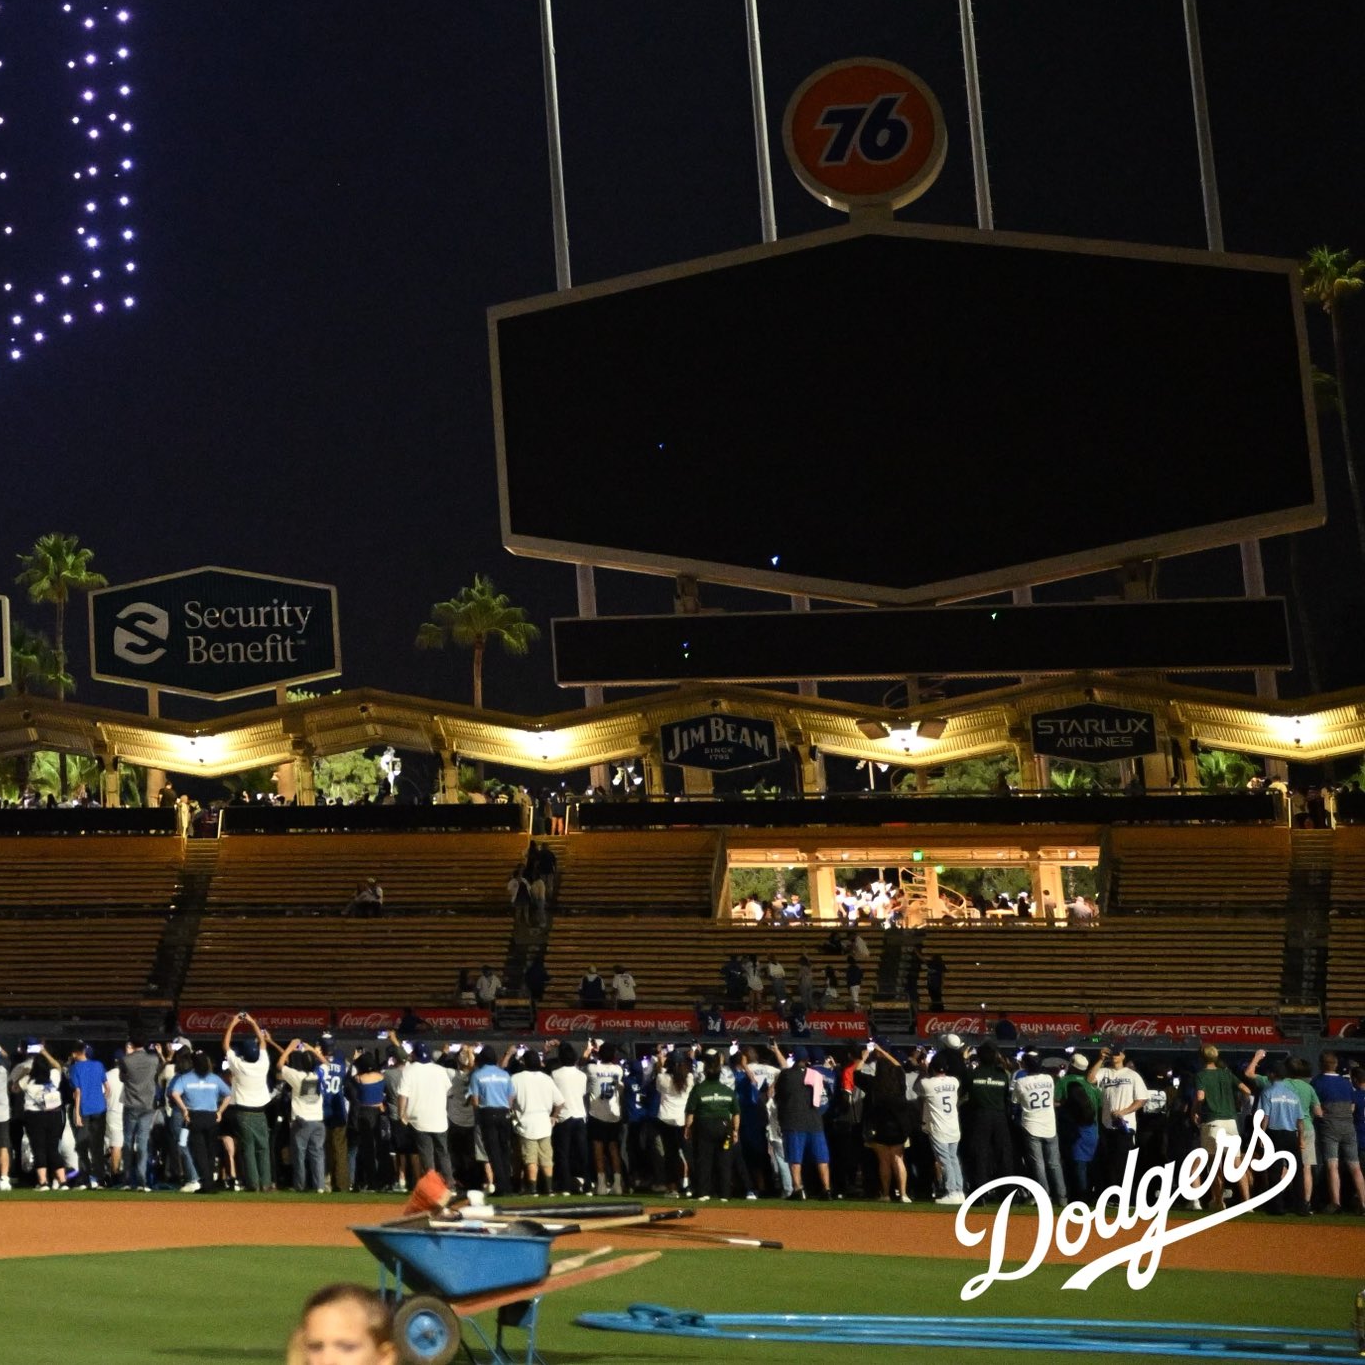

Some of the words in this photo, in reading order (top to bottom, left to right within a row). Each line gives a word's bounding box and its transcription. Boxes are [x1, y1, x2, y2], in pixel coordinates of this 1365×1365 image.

[814, 92, 913, 168] 76
[185, 597, 313, 634] Security
[187, 634, 297, 665] Benefit
[1036, 719, 1149, 735] STARLUX
[667, 725, 705, 761] JIM
[710, 717, 770, 757] BEAM
[1056, 736, 1134, 748] AIRLINES
[271, 1017, 291, 1025] RUN
[293, 1017, 325, 1025] MAGIC
[463, 1018, 490, 1026] TIME
[601, 1019, 632, 1028] HOME
[634, 1019, 655, 1028] RUN
[658, 1019, 691, 1028] MAGIC
[777, 1020, 789, 1029] HI
[806, 1021, 834, 1030] VERY
[837, 1022, 866, 1030] TIME
[1020, 1023, 1043, 1032] RUN
[1046, 1023, 1082, 1032] MAGIC
[1165, 1026, 1174, 1034] A
[1176, 1025, 1197, 1034] HIT
[1200, 1026, 1240, 1035] EVERY
[1242, 1026, 1274, 1035] TIME
[942, 1096, 952, 1114] 5
[1029, 1091, 1051, 1110] 22
